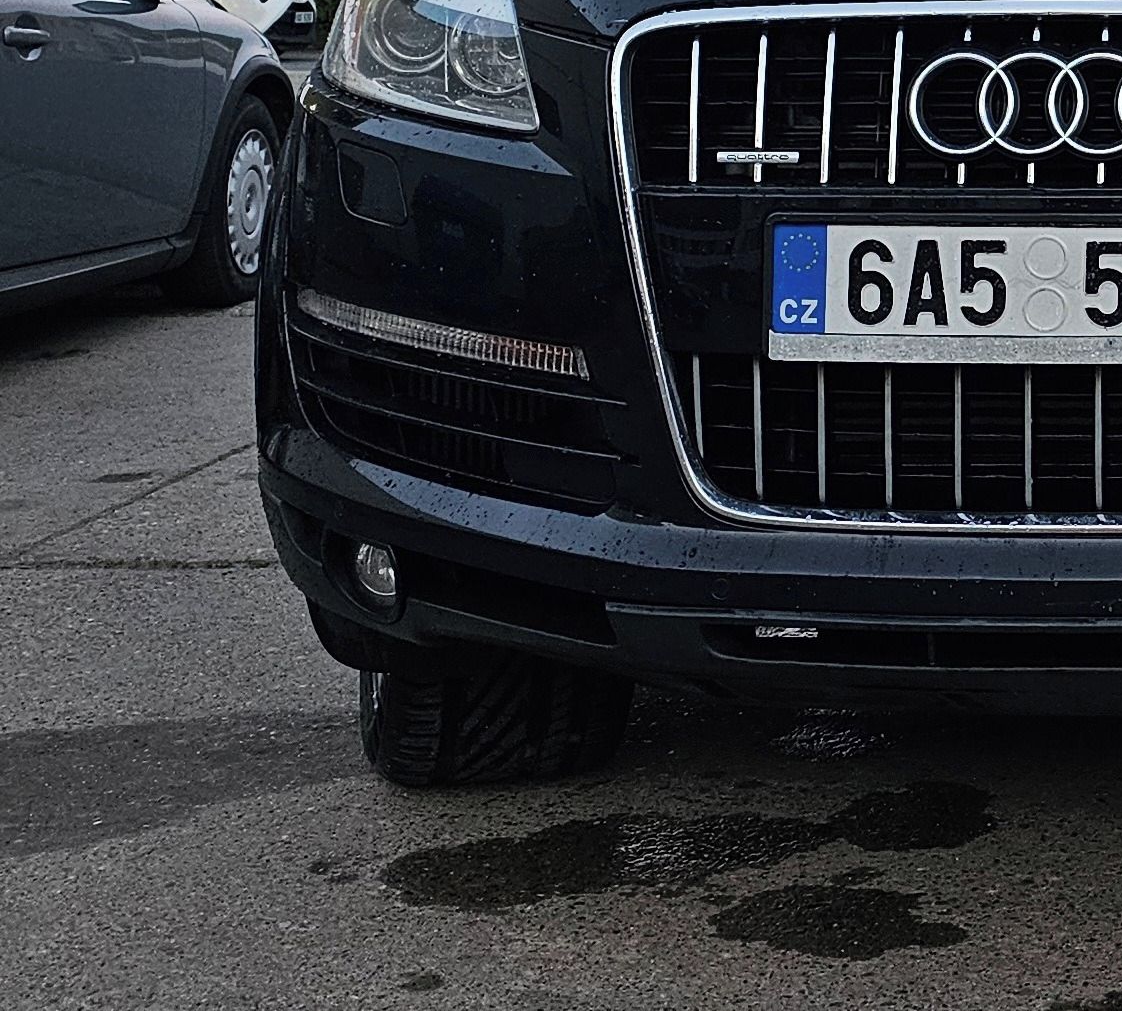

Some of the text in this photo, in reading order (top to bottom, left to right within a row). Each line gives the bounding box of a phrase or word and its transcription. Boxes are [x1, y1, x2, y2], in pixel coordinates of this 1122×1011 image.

[727, 153, 789, 161] quattro
[847, 239, 1009, 327] 6A5
[778, 299, 818, 325] CZ
